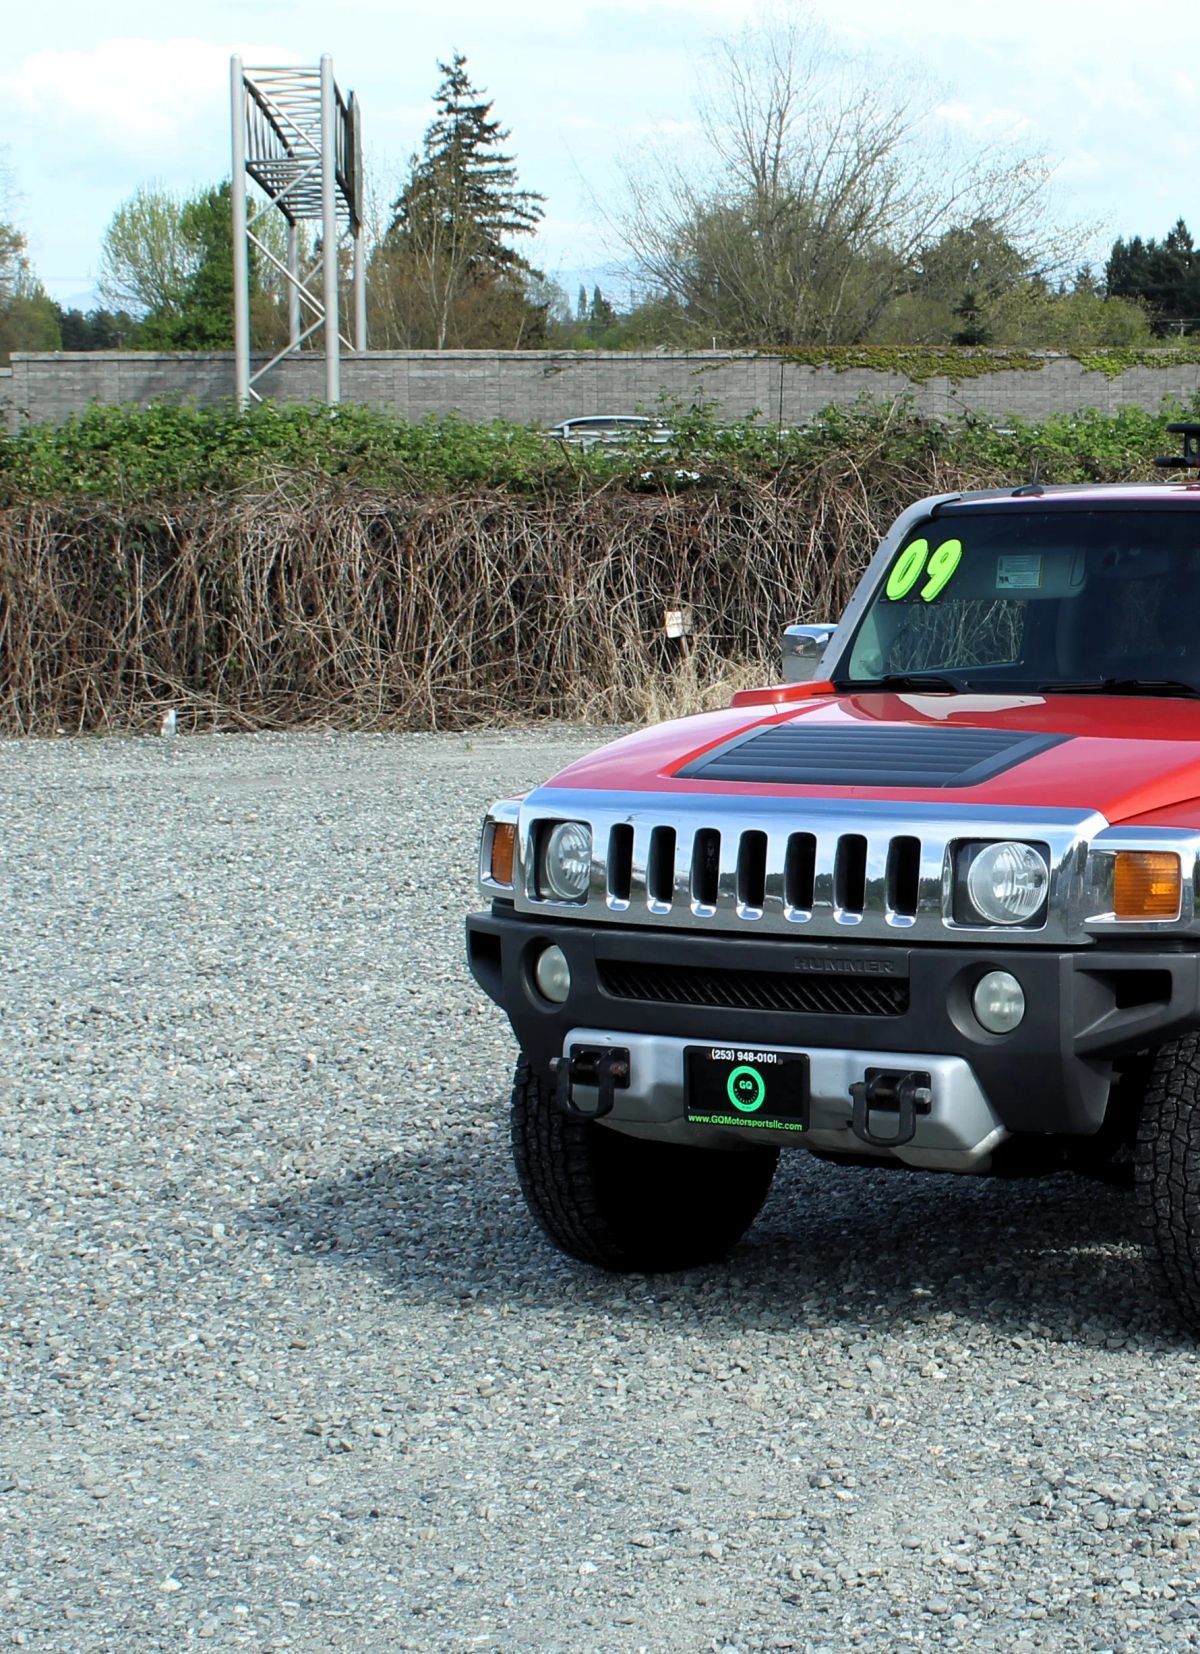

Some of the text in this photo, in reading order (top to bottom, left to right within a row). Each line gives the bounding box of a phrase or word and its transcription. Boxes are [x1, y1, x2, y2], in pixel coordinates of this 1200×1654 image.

[886, 538, 962, 602] 09
[794, 957, 893, 973] HUMMER
[711, 1048, 777, 1064] (253) 948-0101
[739, 1080, 753, 1090] GQ
[688, 1114, 802, 1131] www.GQMotorsportsllc.com
